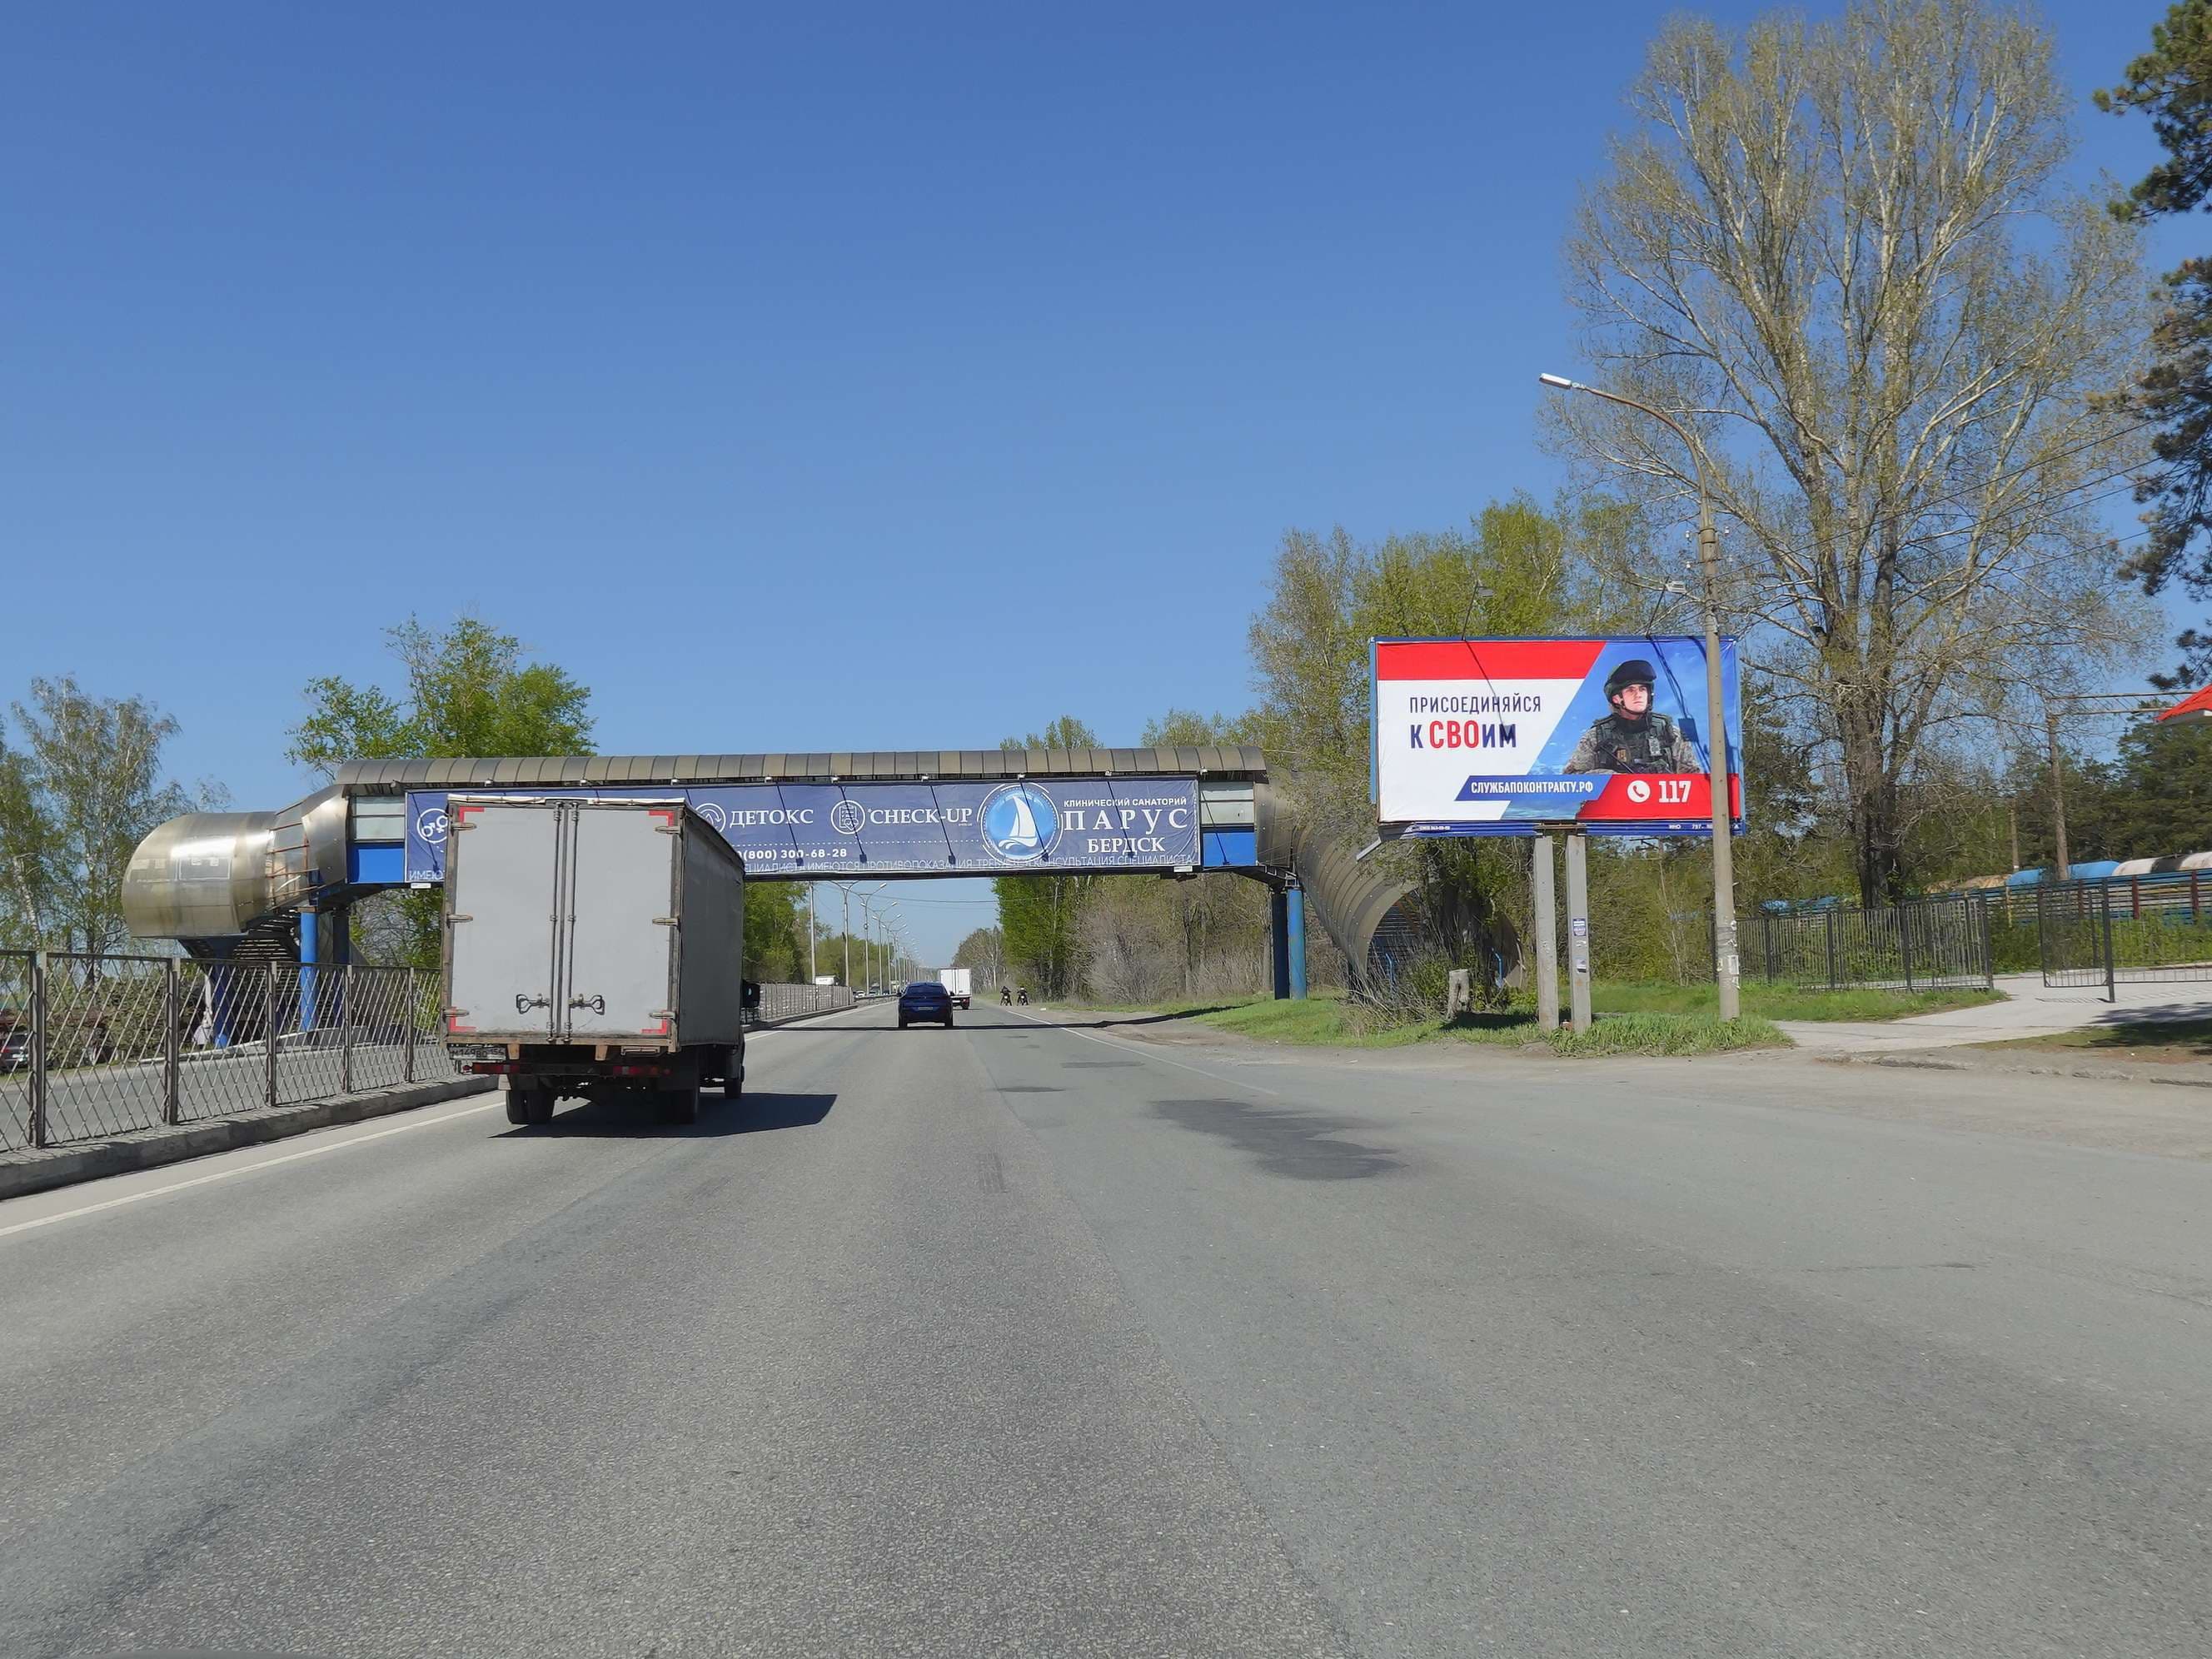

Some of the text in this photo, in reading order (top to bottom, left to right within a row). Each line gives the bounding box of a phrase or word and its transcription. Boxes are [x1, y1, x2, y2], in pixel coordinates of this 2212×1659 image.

[1409, 694, 1541, 715] ПРИСОЕДИНЯЙСЯ
[1471, 781, 1593, 794] СЛУЖБАПОКОНТРАКТУ.РФ
[1658, 780, 1691, 803] 117
[1064, 797, 1187, 807] КЛИНИЧЕСКИЙ САНАТОРИЙ
[730, 809, 814, 828] ДЕТОКС
[1064, 809, 1188, 835] ПАРУС
[738, 849, 847, 861] (800) 300-68-28
[1088, 837, 1166, 856] БЕРДСК
[409, 869, 446, 882] ИМЕЮ
